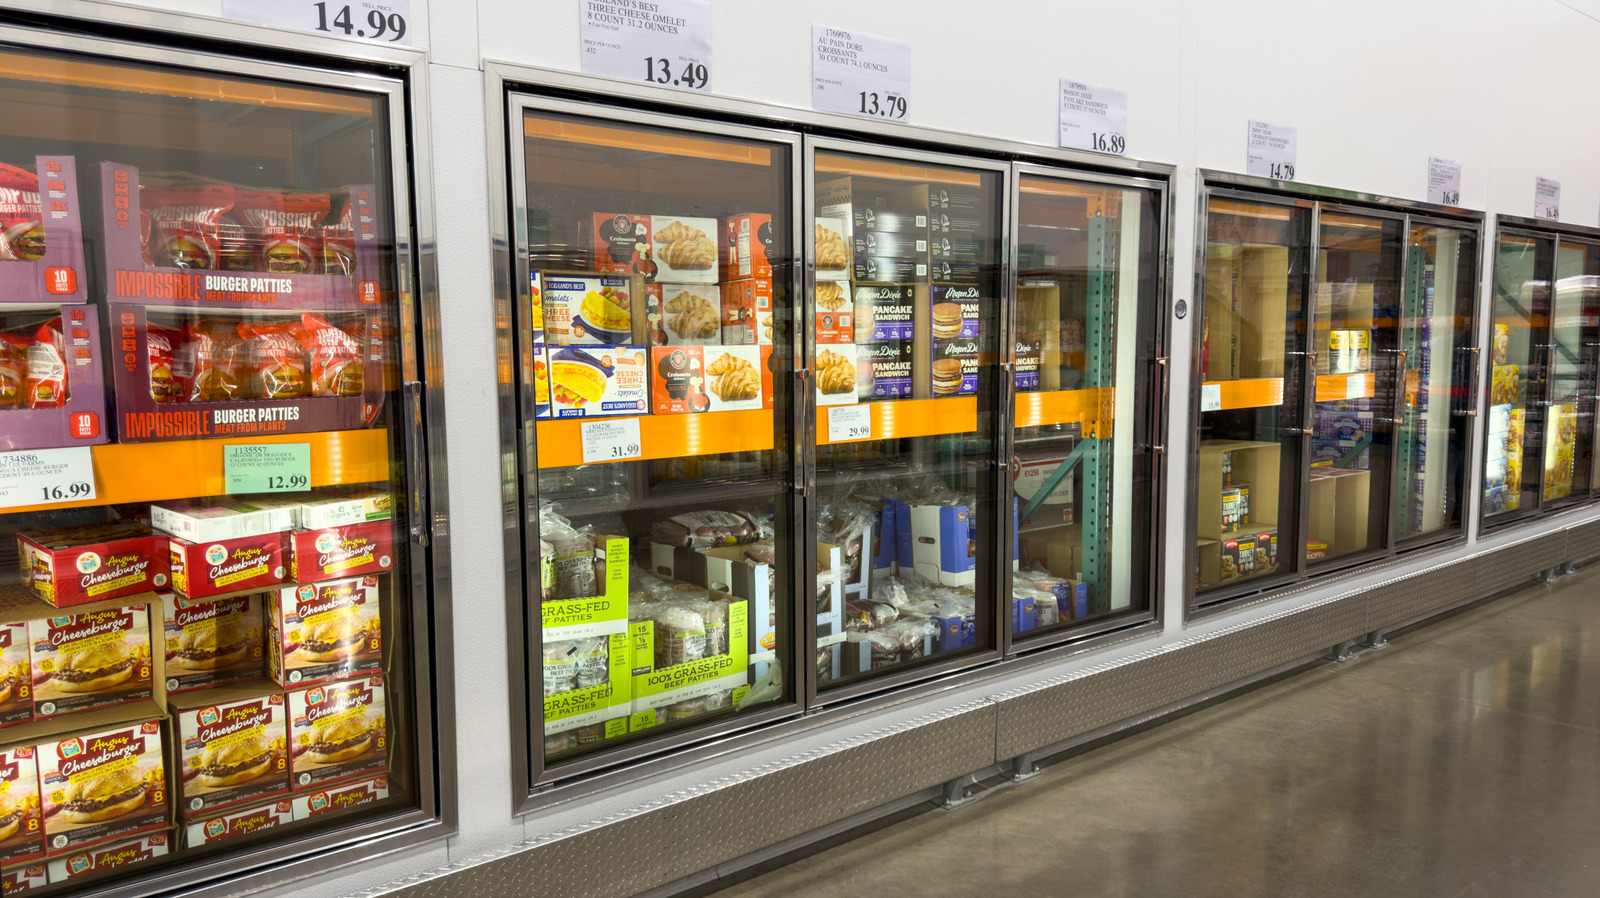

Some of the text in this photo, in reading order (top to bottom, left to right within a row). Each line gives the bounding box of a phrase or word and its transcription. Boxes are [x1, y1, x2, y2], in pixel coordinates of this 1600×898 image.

[639, 2, 659, 13] BEST
[587, 2, 686, 27] THREE CHEESE OMELET
[314, 2, 406, 42] 14.99
[594, 13, 625, 25] COUNT
[627, 19, 643, 29] 31.2
[644, 21, 678, 35] OUNCES
[826, 28, 852, 40] 1769976
[830, 39, 845, 48] PAIN
[846, 43, 864, 52] DORE
[818, 46, 858, 59] CROISSANTS
[826, 55, 849, 65] COUNT
[863, 62, 888, 72] OUNCES
[644, 56, 708, 89] 13.49
[859, 91, 907, 119] 13.79
[1092, 132, 1125, 154] 16.89
[1270, 163, 1294, 180] 14.79
[1442, 191, 1459, 205] 16.49
[18, 204, 42, 213] PATTIES
[54, 270, 67, 282] 10
[115, 270, 293, 300] IMPOSSIBLE BURGER PATTIES
[364, 283, 374, 294] 10
[206, 291, 276, 303] MEAT FROM PLANTS
[856, 288, 902, 300] Mason Dixie
[946, 287, 968, 299] Mason
[872, 306, 912, 314] PANCAKE
[856, 344, 901, 357] Mason Dixie
[946, 343, 968, 355] Mason
[872, 362, 911, 370] PANCAKE
[617, 389, 643, 397] Omelets
[78, 415, 91, 427] 10
[125, 407, 300, 439] IMPOSSIBLE BURGER PATTIES
[215, 421, 286, 434] MEAT FROM PLANTS
[849, 427, 869, 436] 29.99
[611, 444, 639, 457] 31.99
[2, 454, 38, 464] 734886
[267, 475, 307, 489] 12.99
[42, 482, 91, 500] 16.99
[340, 537, 367, 549] Angus
[232, 547, 262, 560] Angus
[319, 543, 376, 566] Cheeseburger
[106, 554, 139, 567] Angus
[210, 554, 271, 579] Cheeseburger
[81, 560, 149, 588] Cheeseburger
[322, 586, 354, 598] Angus
[299, 592, 363, 618] Cheeseburger
[80, 611, 118, 624] Angus
[178, 600, 246, 626] Cheeseburger
[554, 614, 592, 624] PATTIES
[52, 617, 129, 645] Cheeseburger
[370, 640, 379, 649] 8
[254, 647, 262, 657] 8
[140, 667, 150, 678] 8
[648, 658, 733, 686] 100% GRASS-FED
[664, 671, 718, 689] BEEF PATTIES
[19, 686, 29, 697] 8
[330, 688, 360, 701] Angus
[544, 687, 613, 711] GRASS-FED
[225, 706, 259, 720] Angus
[308, 693, 369, 721] Cheeseburger
[559, 702, 596, 715] PATTIES
[200, 711, 268, 743] Cheeseburger
[90, 736, 129, 752] Angus
[377, 737, 385, 748] 8
[62, 742, 141, 776] Cheeseburger
[277, 758, 286, 770] 8
[154, 791, 163, 802] 8
[334, 791, 364, 804] Angus
[28, 819, 38, 831] 8
[233, 816, 266, 830] Angus
[99, 849, 137, 866] Angus
